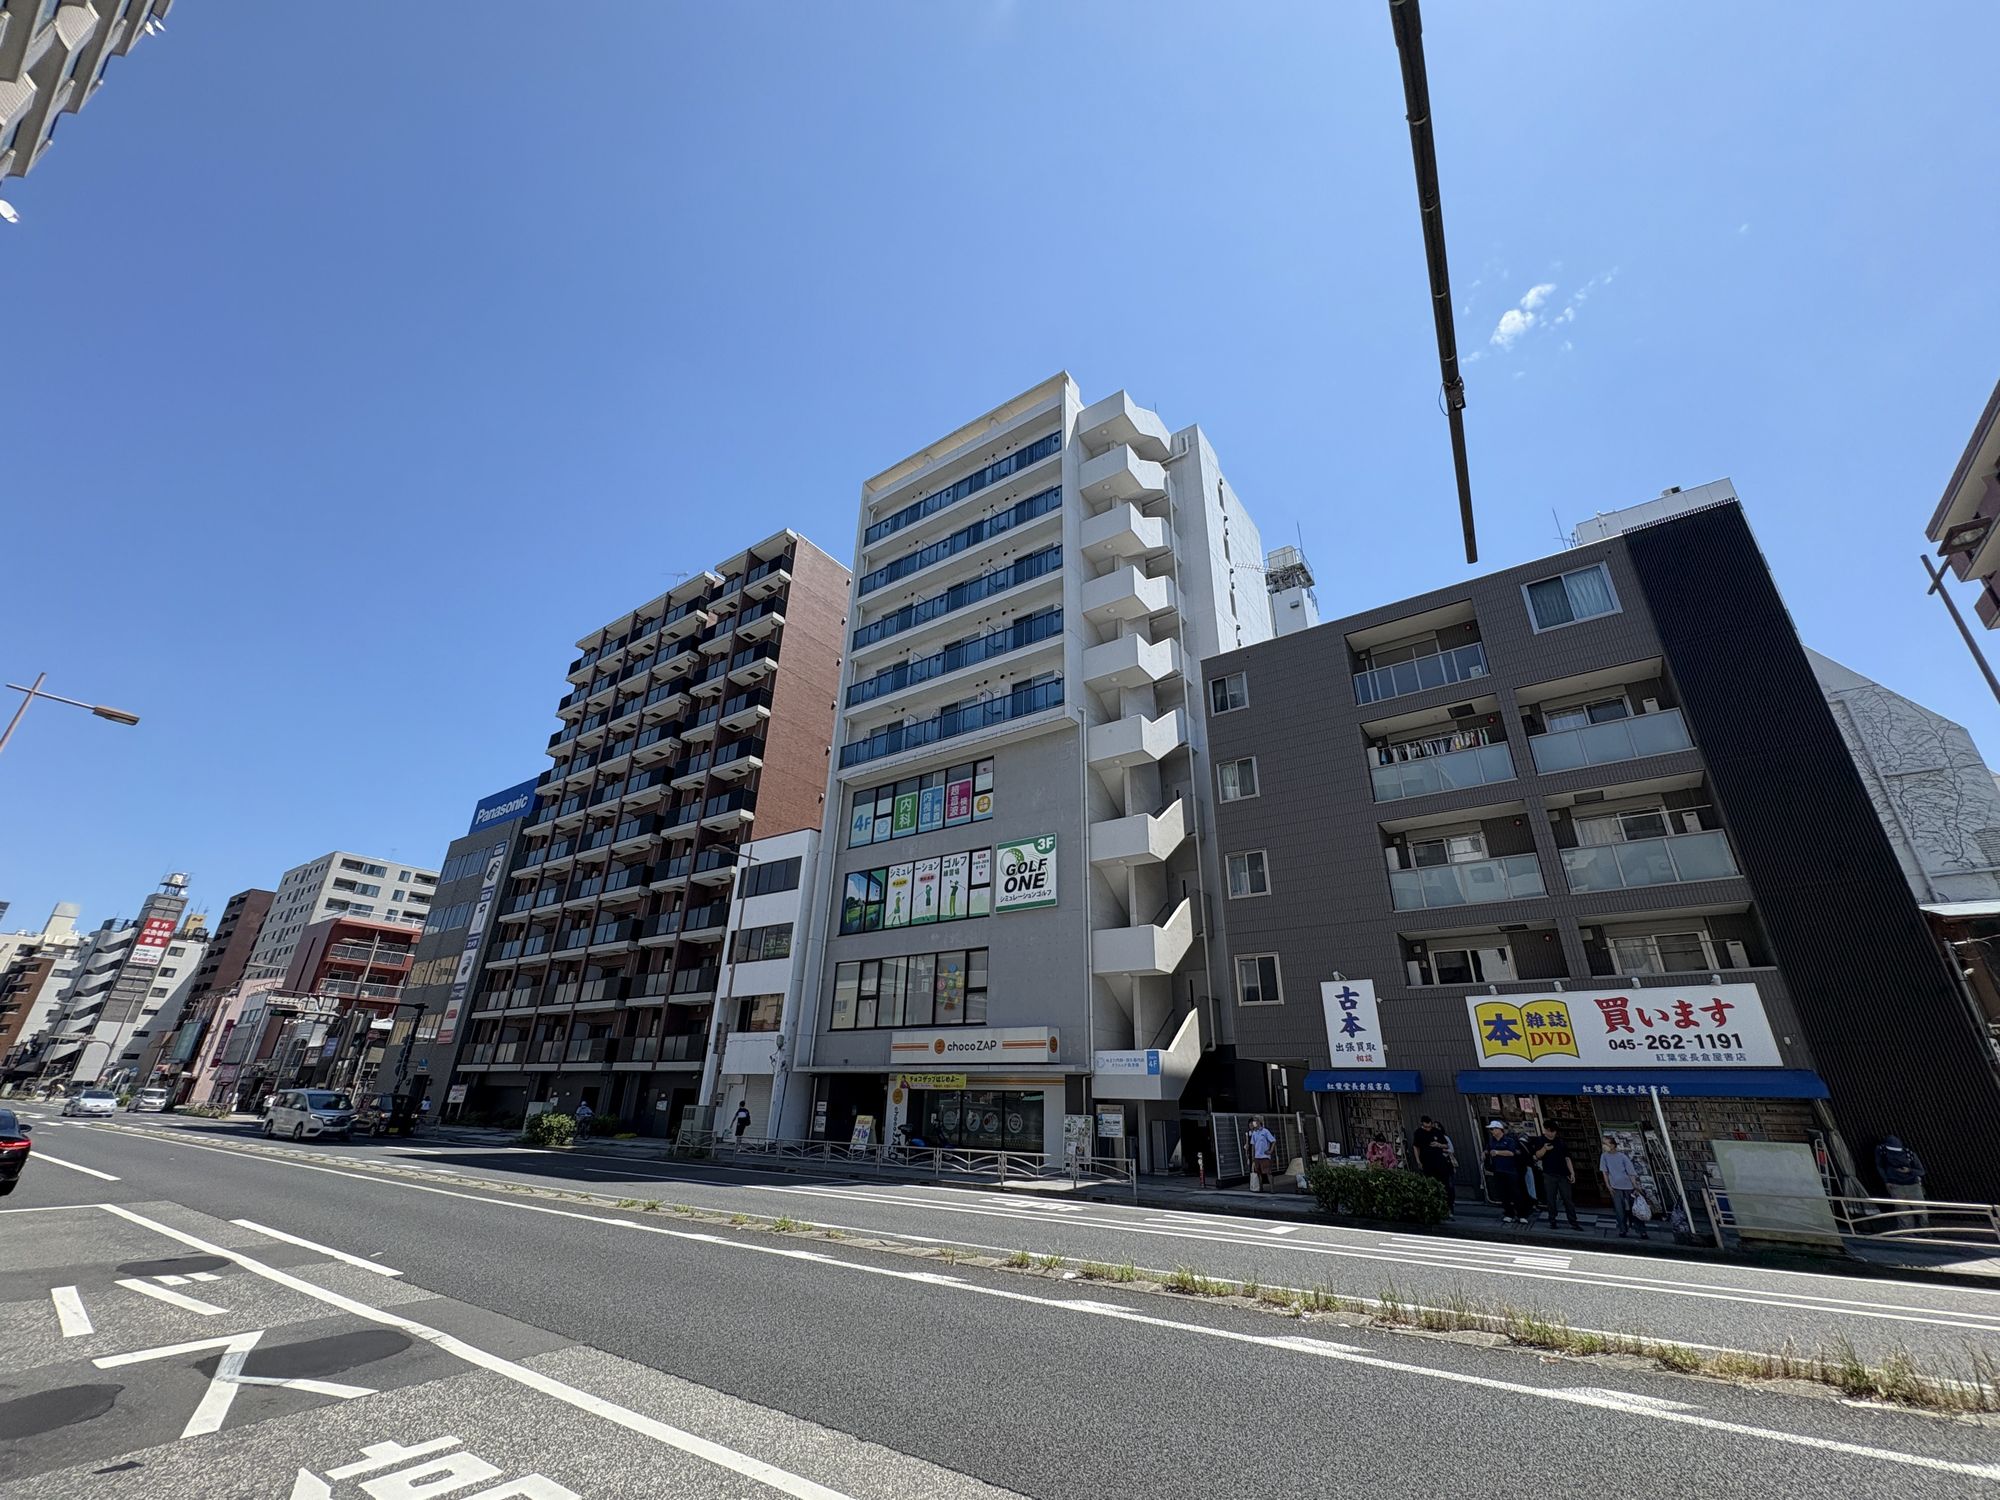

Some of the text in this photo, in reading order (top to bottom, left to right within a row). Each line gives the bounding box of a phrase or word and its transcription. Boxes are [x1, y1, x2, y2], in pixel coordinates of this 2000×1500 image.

[475, 793, 529, 825] Panasonic
[898, 798, 912, 828] 内科
[853, 814, 872, 832] 4F
[1037, 836, 1054, 850] 3F
[1006, 857, 1048, 876] GOLF
[1004, 871, 1046, 894] ONE
[1334, 985, 1367, 1039] 古本
[1525, 1011, 1568, 1029] 雑誌
[1593, 996, 1735, 1034] 買います
[1483, 1013, 1523, 1047] 本
[1529, 1031, 1571, 1046] DVD
[947, 1039, 997, 1052] chocoZAP
[1335, 1042, 1377, 1053] 出張買取
[1608, 1032, 1743, 1050] 045-262-1191
[1355, 1054, 1374, 1063] 相談
[1655, 1052, 1747, 1062] 紅葉堂長倉屋書店
[1326, 1082, 1391, 1091] 紅葉堂長倉屋書店
